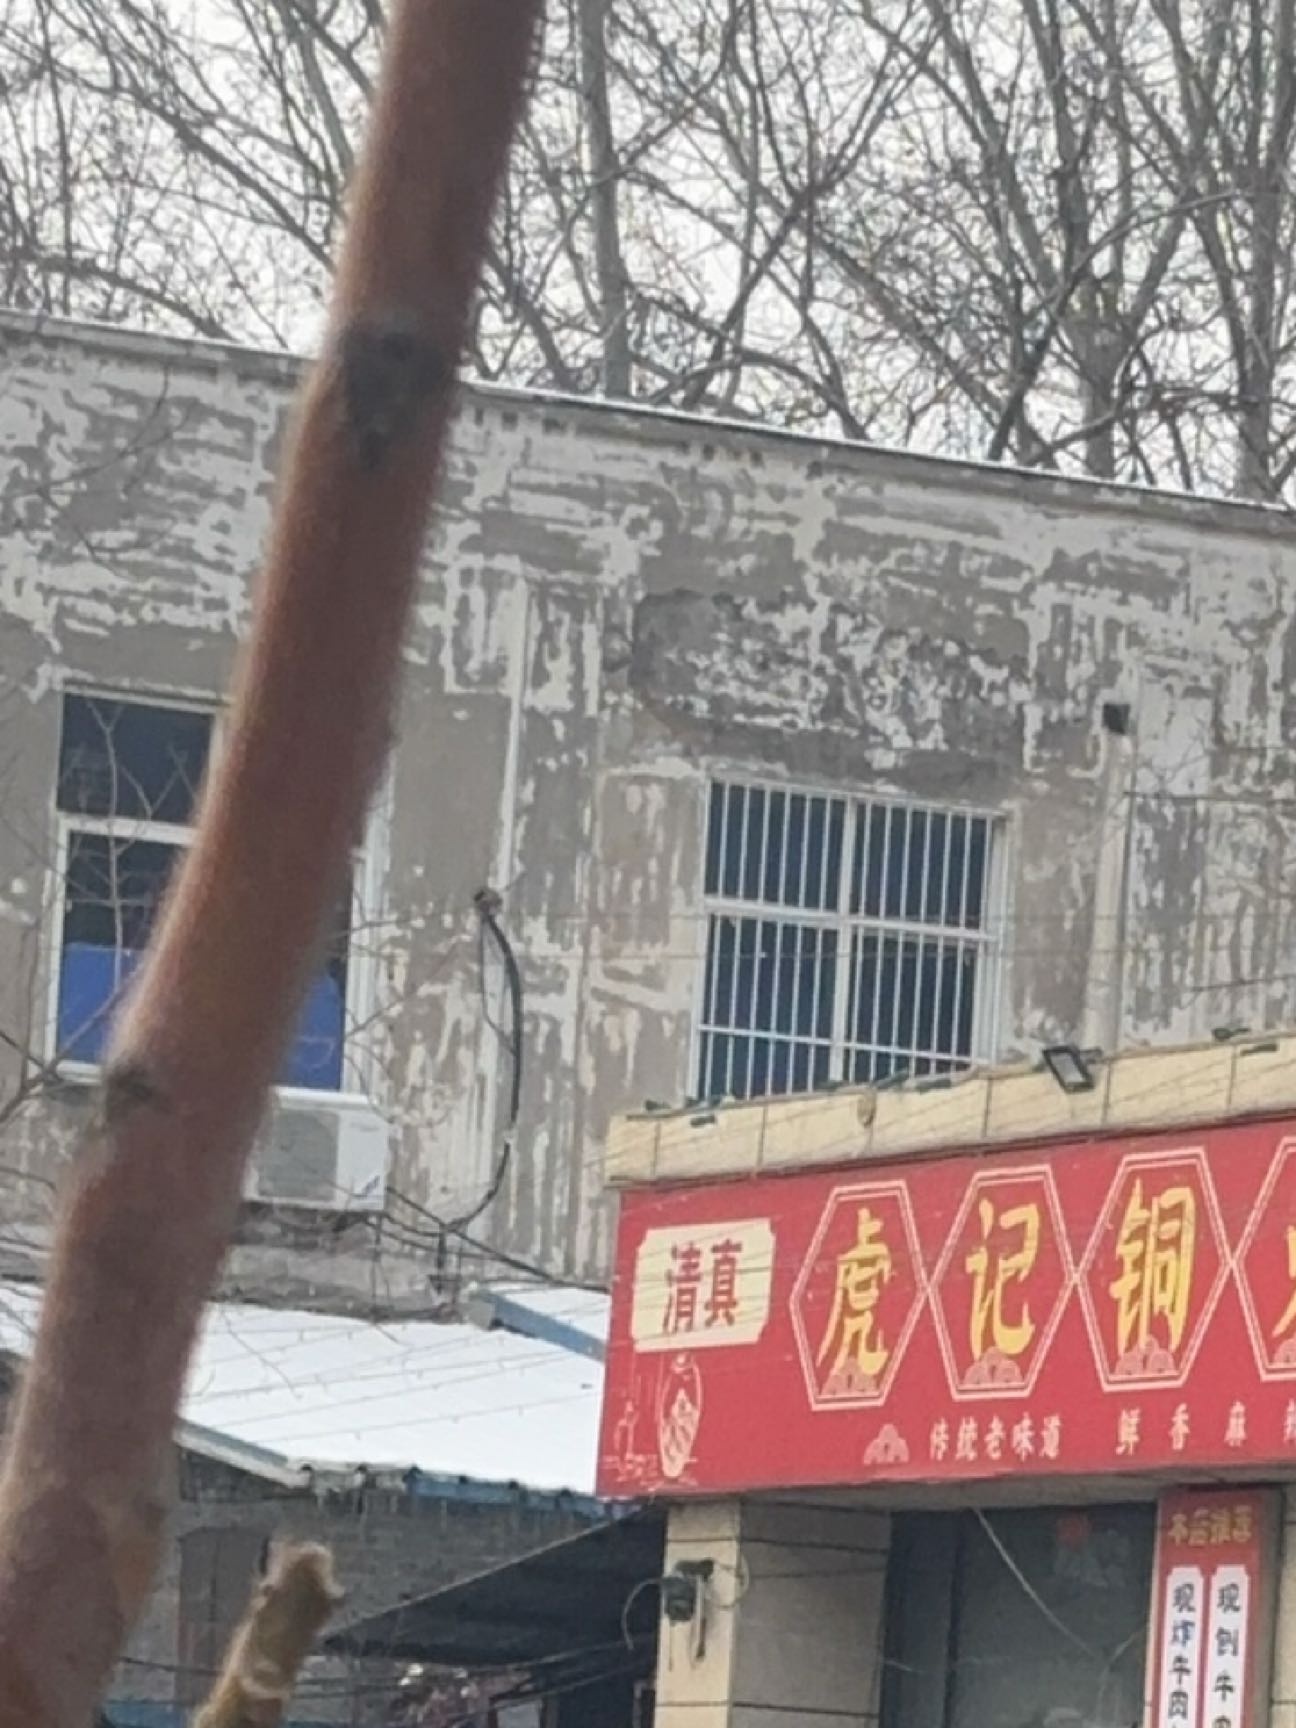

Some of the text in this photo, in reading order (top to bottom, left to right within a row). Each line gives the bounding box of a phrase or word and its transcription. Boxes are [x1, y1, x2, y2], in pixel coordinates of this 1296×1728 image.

[661, 1238, 743, 1333] 清真
[929, 1413, 1063, 1462] 传统老味道
